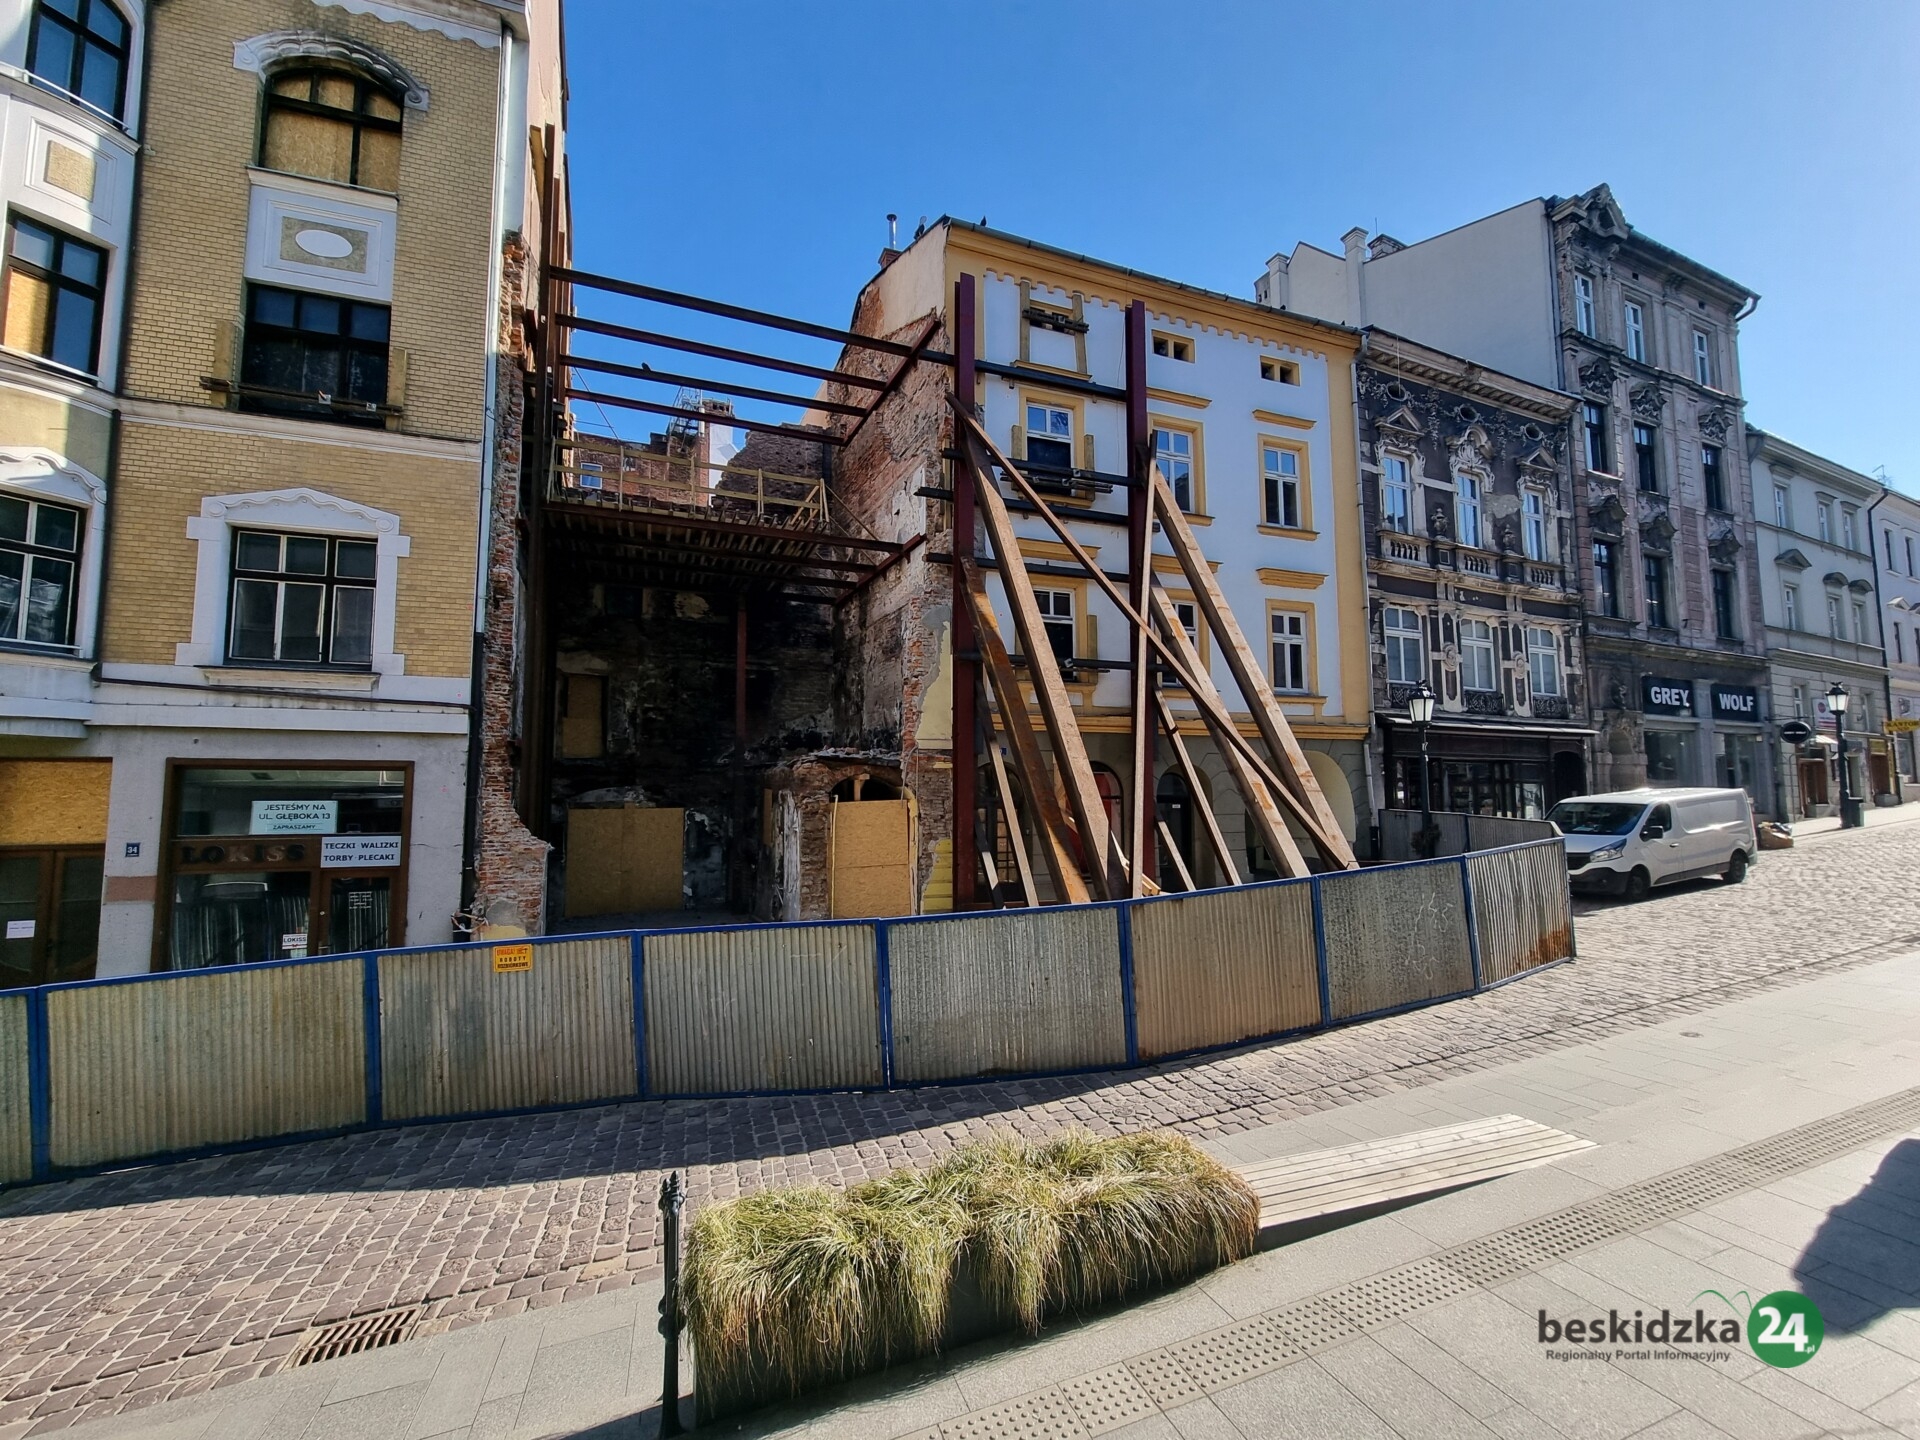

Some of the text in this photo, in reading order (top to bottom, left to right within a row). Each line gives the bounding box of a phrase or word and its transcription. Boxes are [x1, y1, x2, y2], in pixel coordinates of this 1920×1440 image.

[1651, 686, 1754, 712] GREY WOLF
[264, 803, 326, 811] JESTEŚMY NA
[276, 813, 320, 821] GŁĘBOKA
[321, 812, 331, 820] 13
[324, 841, 399, 850] TECZKI WALIZKI
[127, 846, 138, 854] 34
[182, 844, 305, 863] LOKISS
[358, 853, 396, 861] PLECAKI
[283, 936, 307, 944] LOKISS
